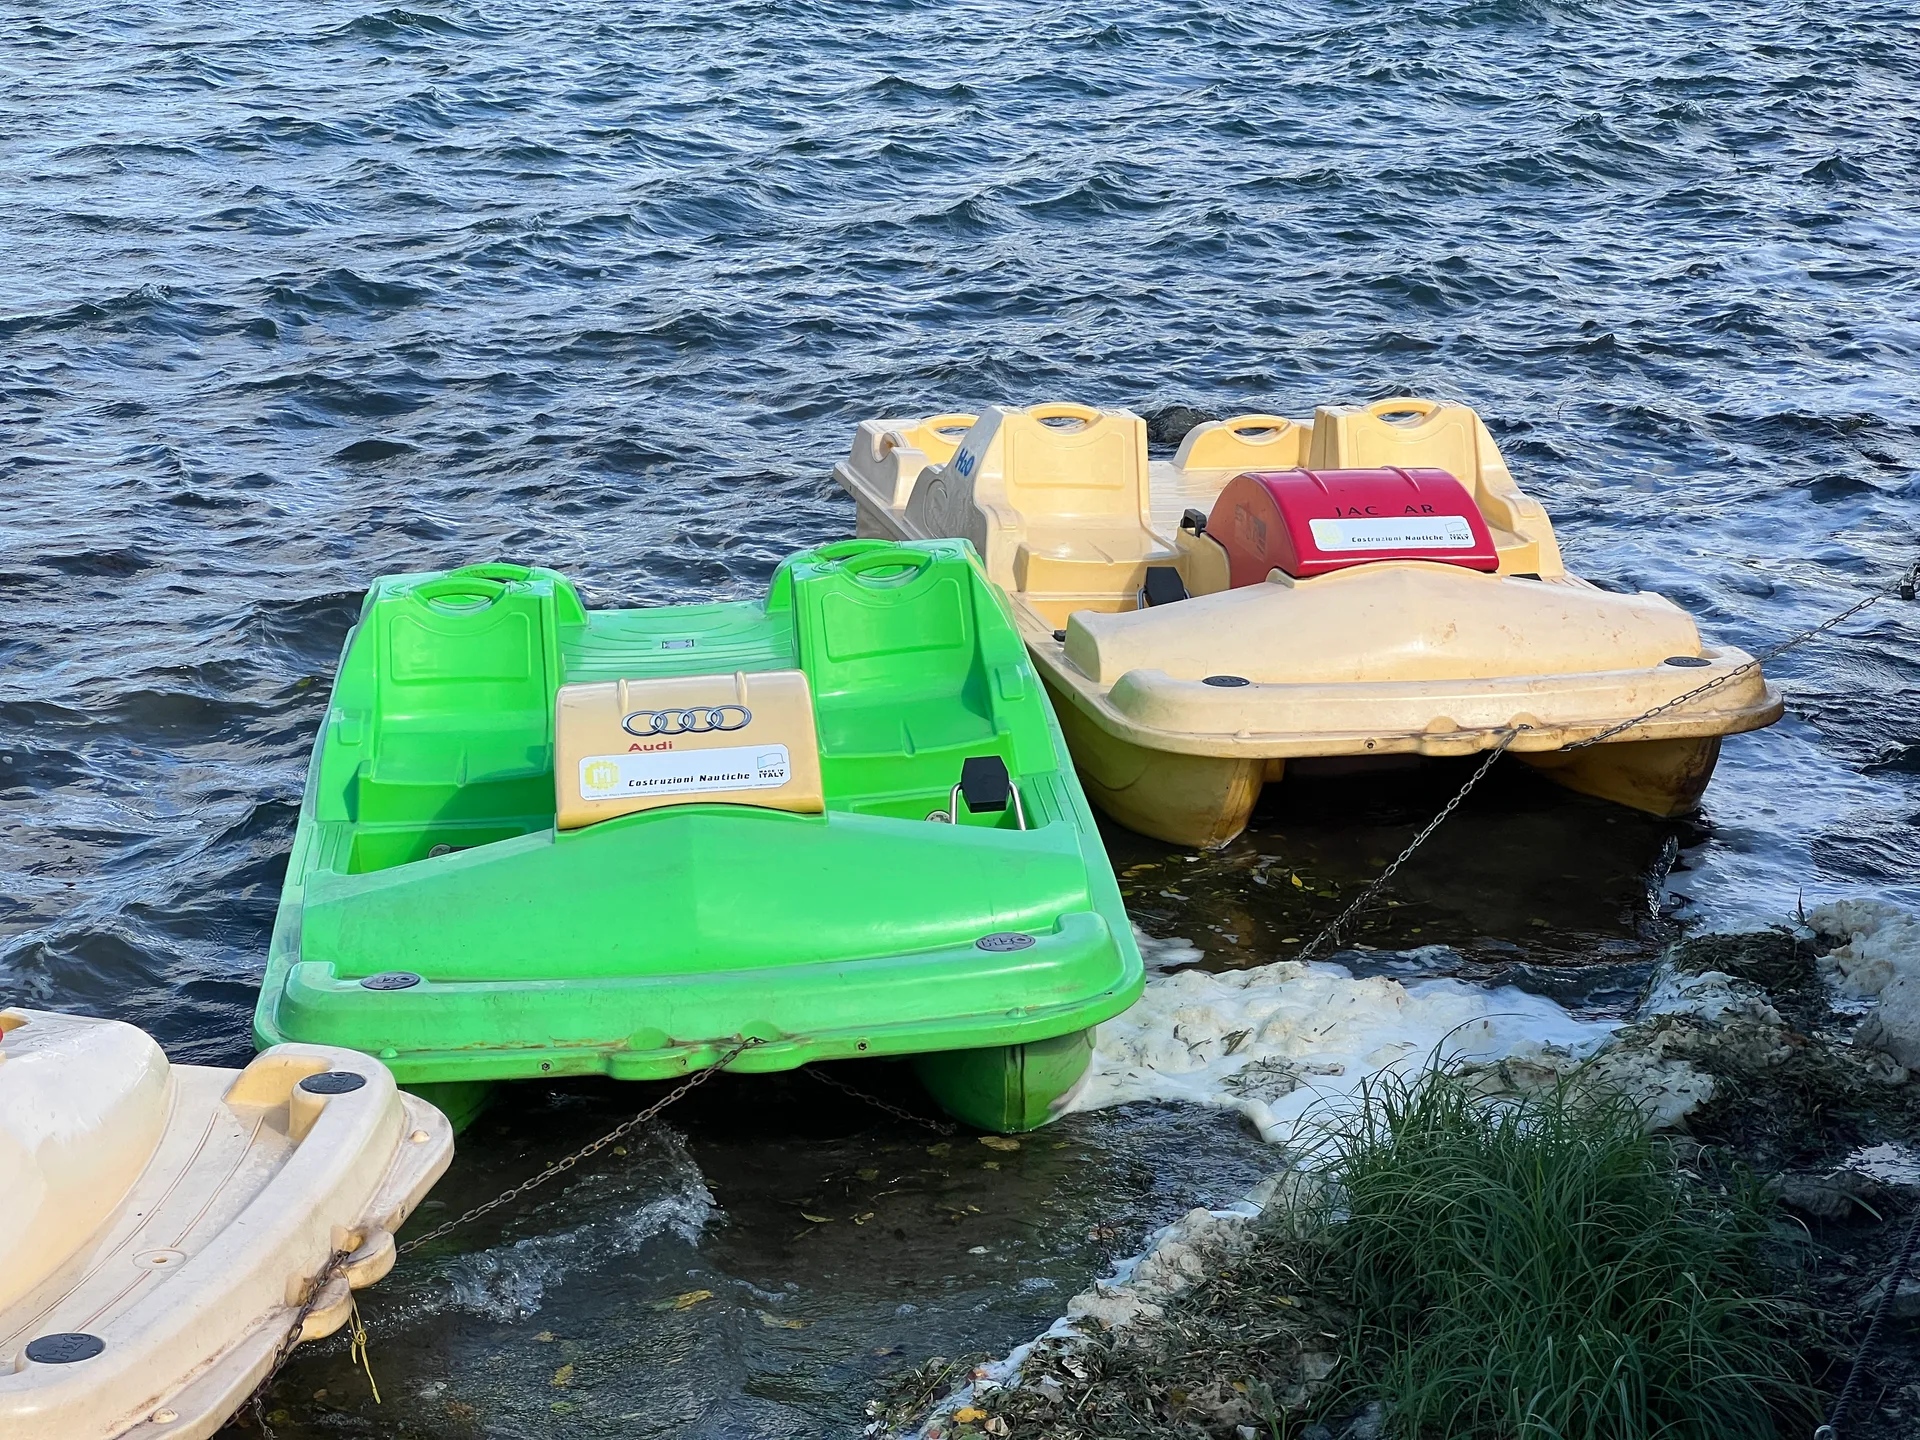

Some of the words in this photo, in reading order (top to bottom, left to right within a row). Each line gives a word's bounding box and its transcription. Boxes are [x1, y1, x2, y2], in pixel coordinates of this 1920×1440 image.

[1351, 535, 1402, 543] Costruzioni
[628, 741, 673, 752] Audi
[628, 775, 694, 787] Costruzioni
[699, 773, 750, 782] Nautiche
